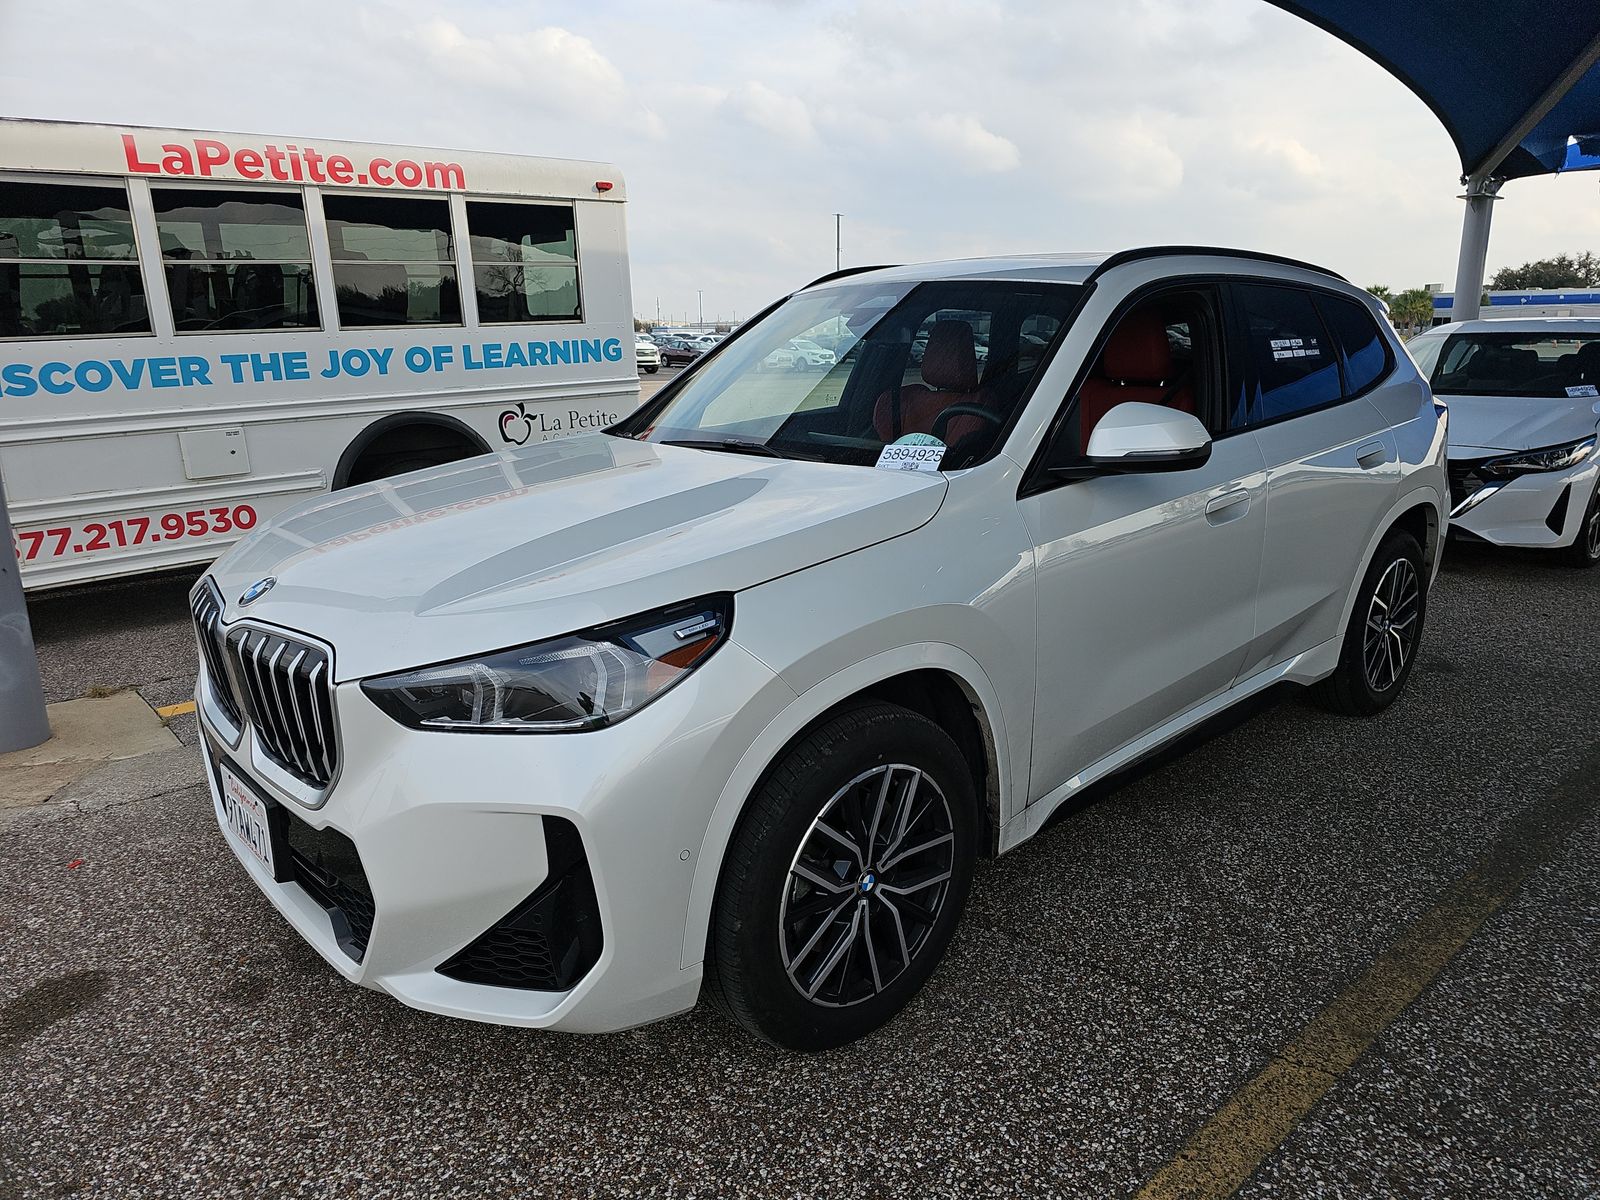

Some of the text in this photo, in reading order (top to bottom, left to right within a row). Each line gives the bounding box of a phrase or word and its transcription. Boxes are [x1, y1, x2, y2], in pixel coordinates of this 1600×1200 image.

[121, 133, 466, 189] LaPetite.com
[0, 337, 623, 398] SCOVER THE JOY OF LEARNING
[539, 410, 618, 432] La Petite
[883, 448, 945, 462] 5894925
